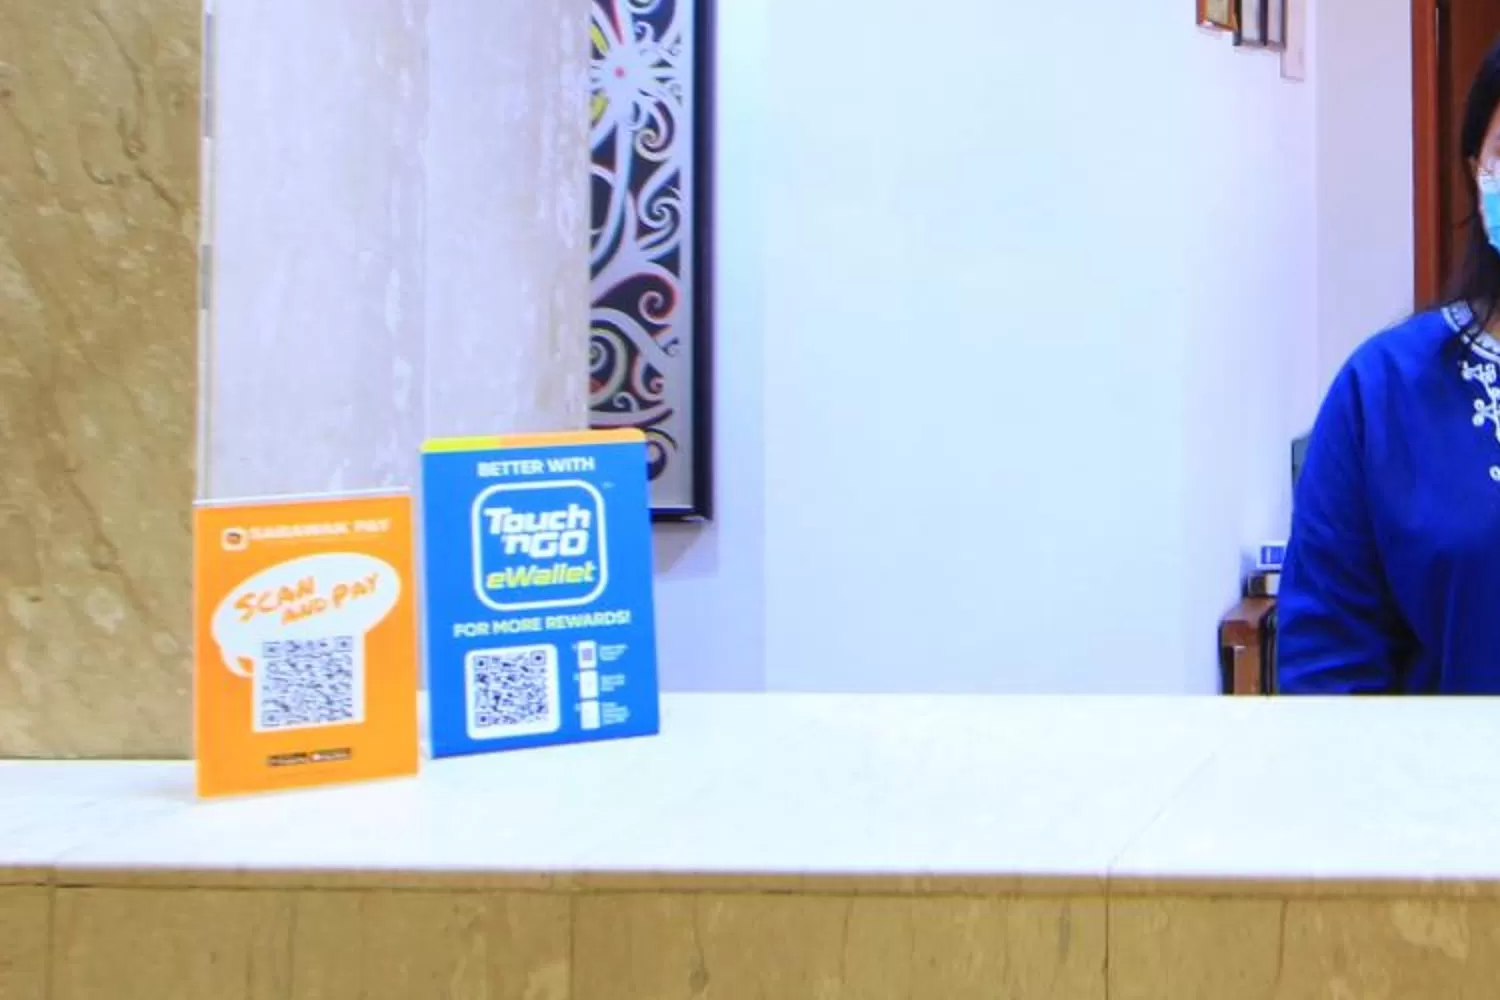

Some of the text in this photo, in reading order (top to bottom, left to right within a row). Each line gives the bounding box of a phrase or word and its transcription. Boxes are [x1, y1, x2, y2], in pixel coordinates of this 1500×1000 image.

[477, 456, 595, 477] BETTER WITH
[484, 503, 591, 535] Touch
[486, 561, 596, 589] eWallet
[233, 575, 315, 623] SCAN
[280, 572, 380, 625] AND PAY
[453, 609, 632, 638] FOR MORE REWARDS!
